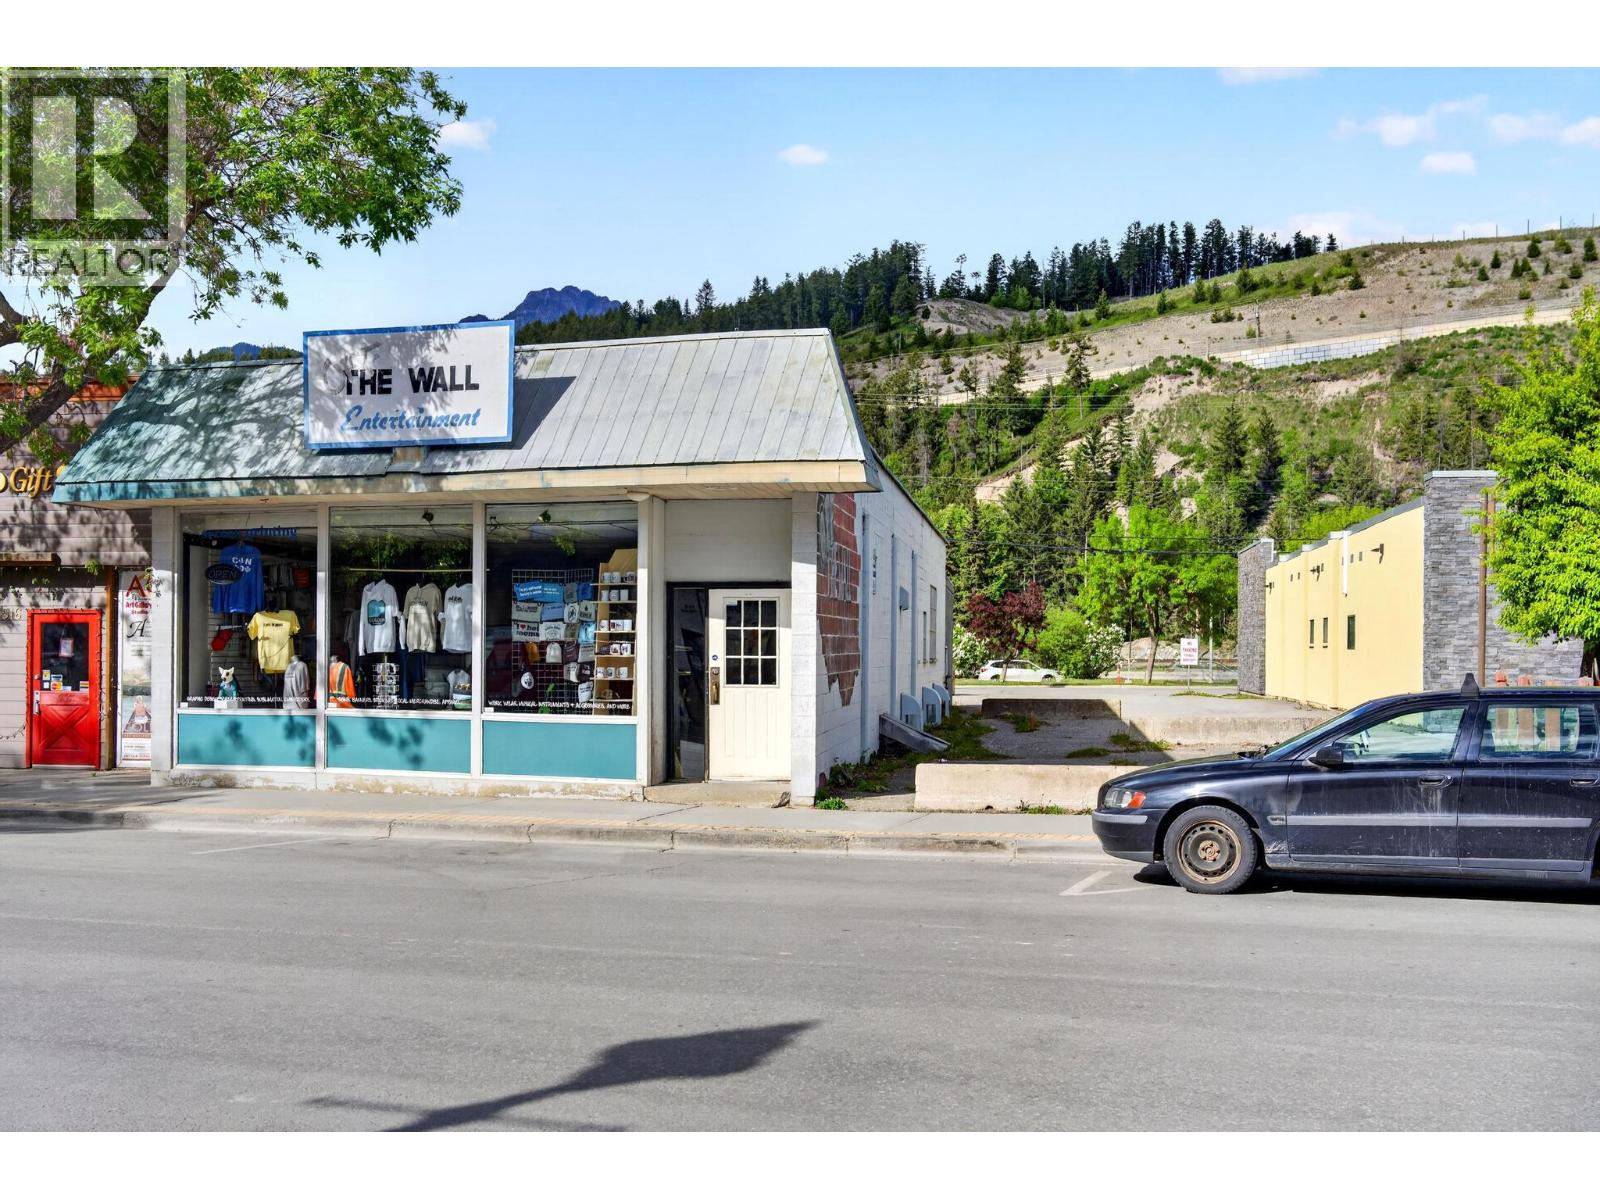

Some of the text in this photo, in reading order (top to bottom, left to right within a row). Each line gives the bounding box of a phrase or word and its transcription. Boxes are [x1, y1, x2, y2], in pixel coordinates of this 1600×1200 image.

[344, 369, 392, 395] THE
[408, 365, 480, 393] WALL
[340, 405, 481, 432] Entertainment
[10, 466, 53, 498] Gift
